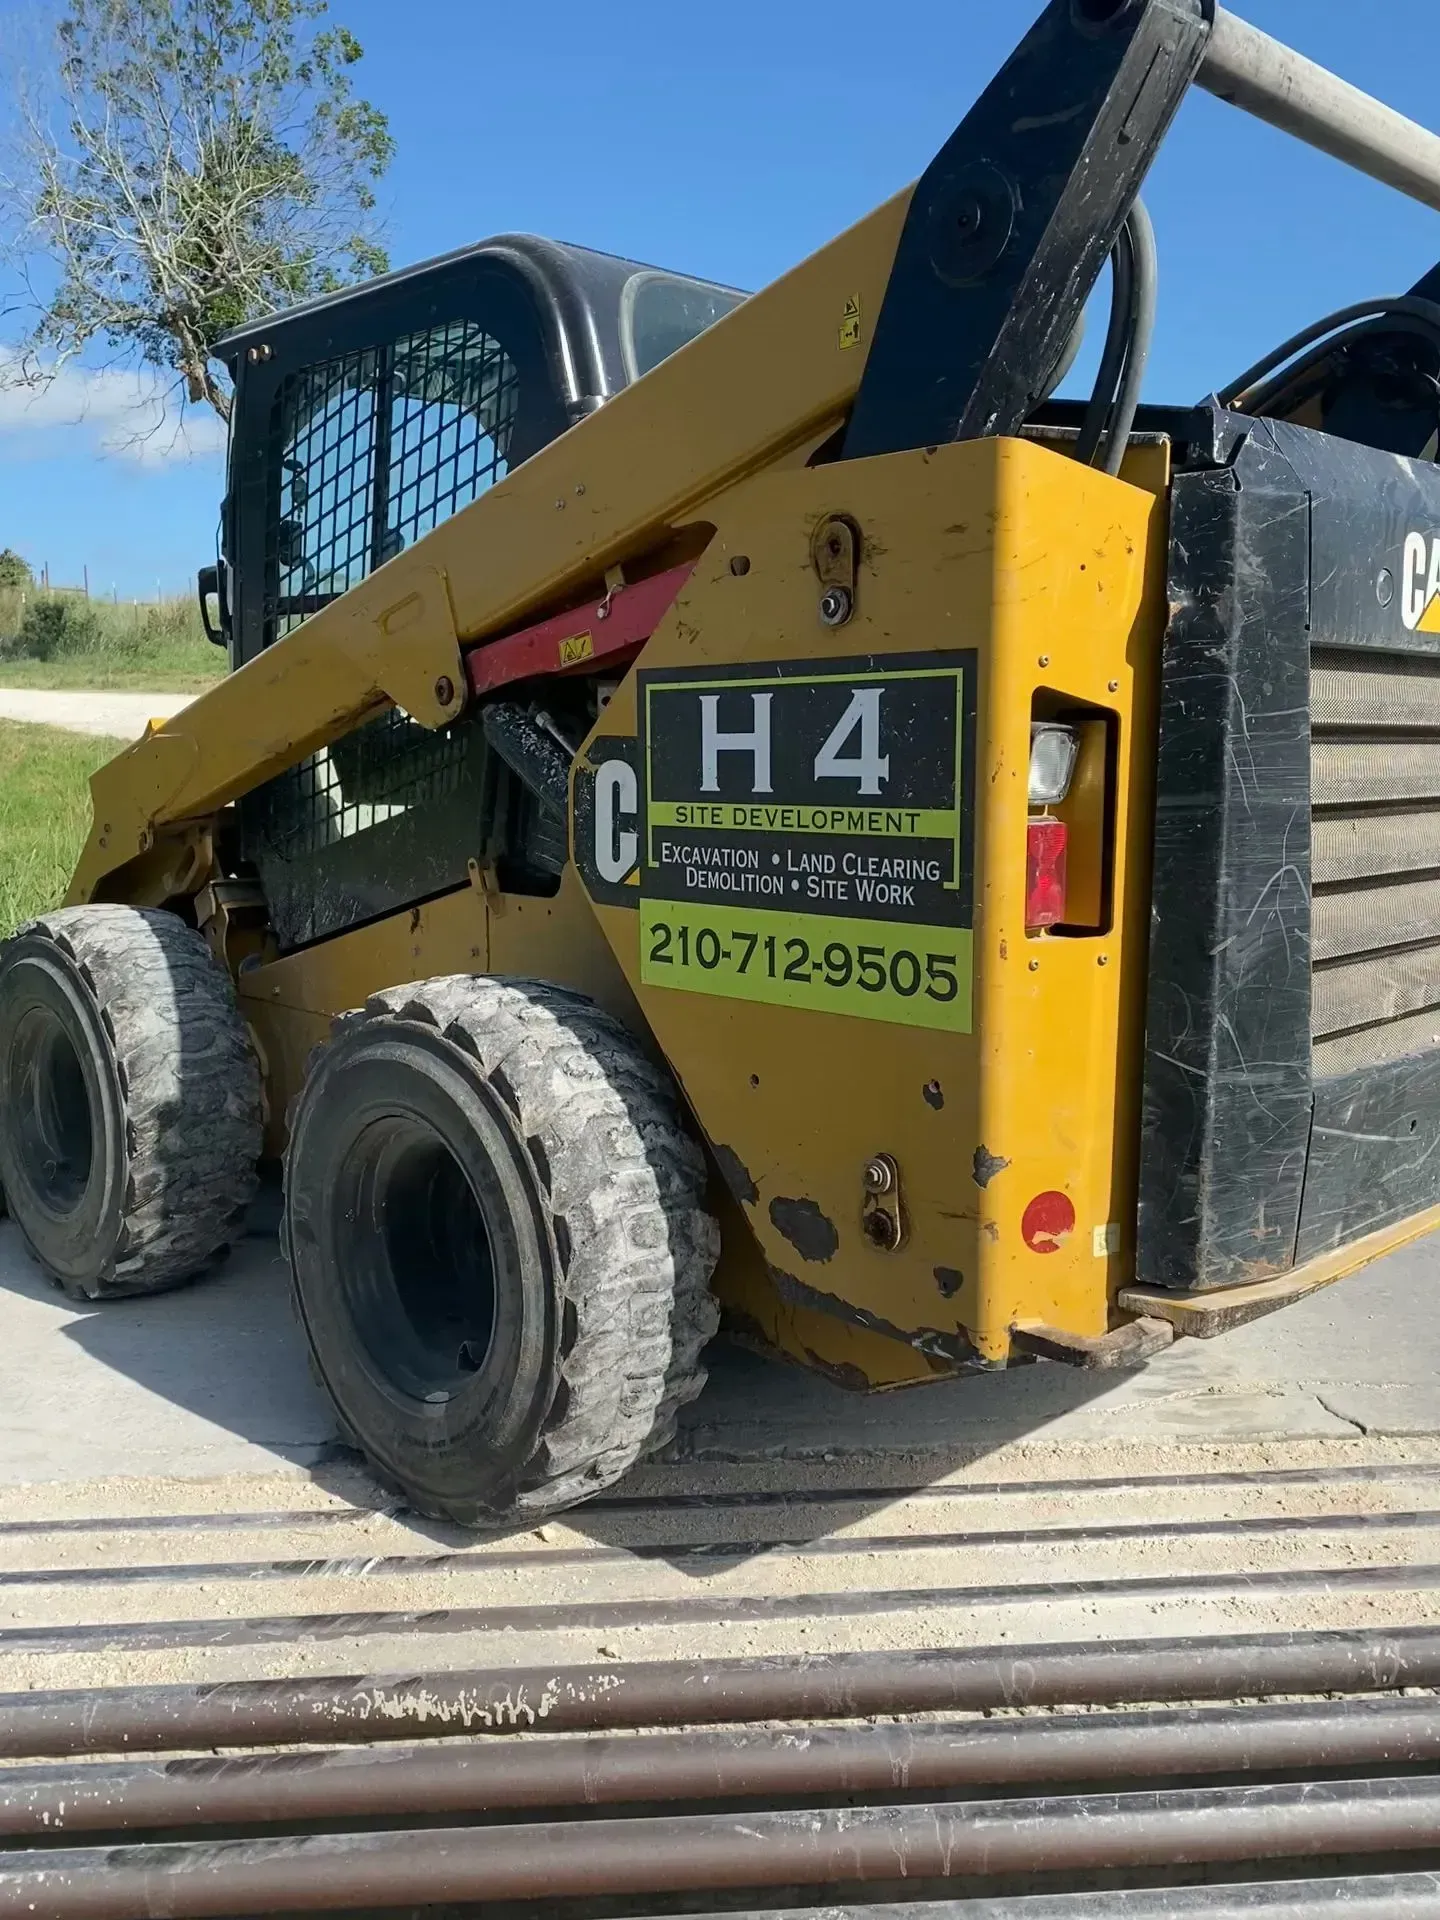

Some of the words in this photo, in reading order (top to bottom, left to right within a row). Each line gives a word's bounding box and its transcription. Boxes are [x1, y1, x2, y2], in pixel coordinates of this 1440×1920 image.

[698, 692, 774, 793] H
[813, 687, 890, 795] 4
[675, 805, 723, 825] SITE
[733, 807, 921, 833] DEVELOPMENT
[661, 842, 759, 869] EXCAVATION
[787, 849, 836, 874] LAND
[842, 852, 941, 881] CLEARING
[685, 866, 784, 895] DEMOLITION
[806, 875, 848, 900] SITE
[855, 878, 915, 906] WORK
[649, 923, 959, 1003] 210-712-9505
